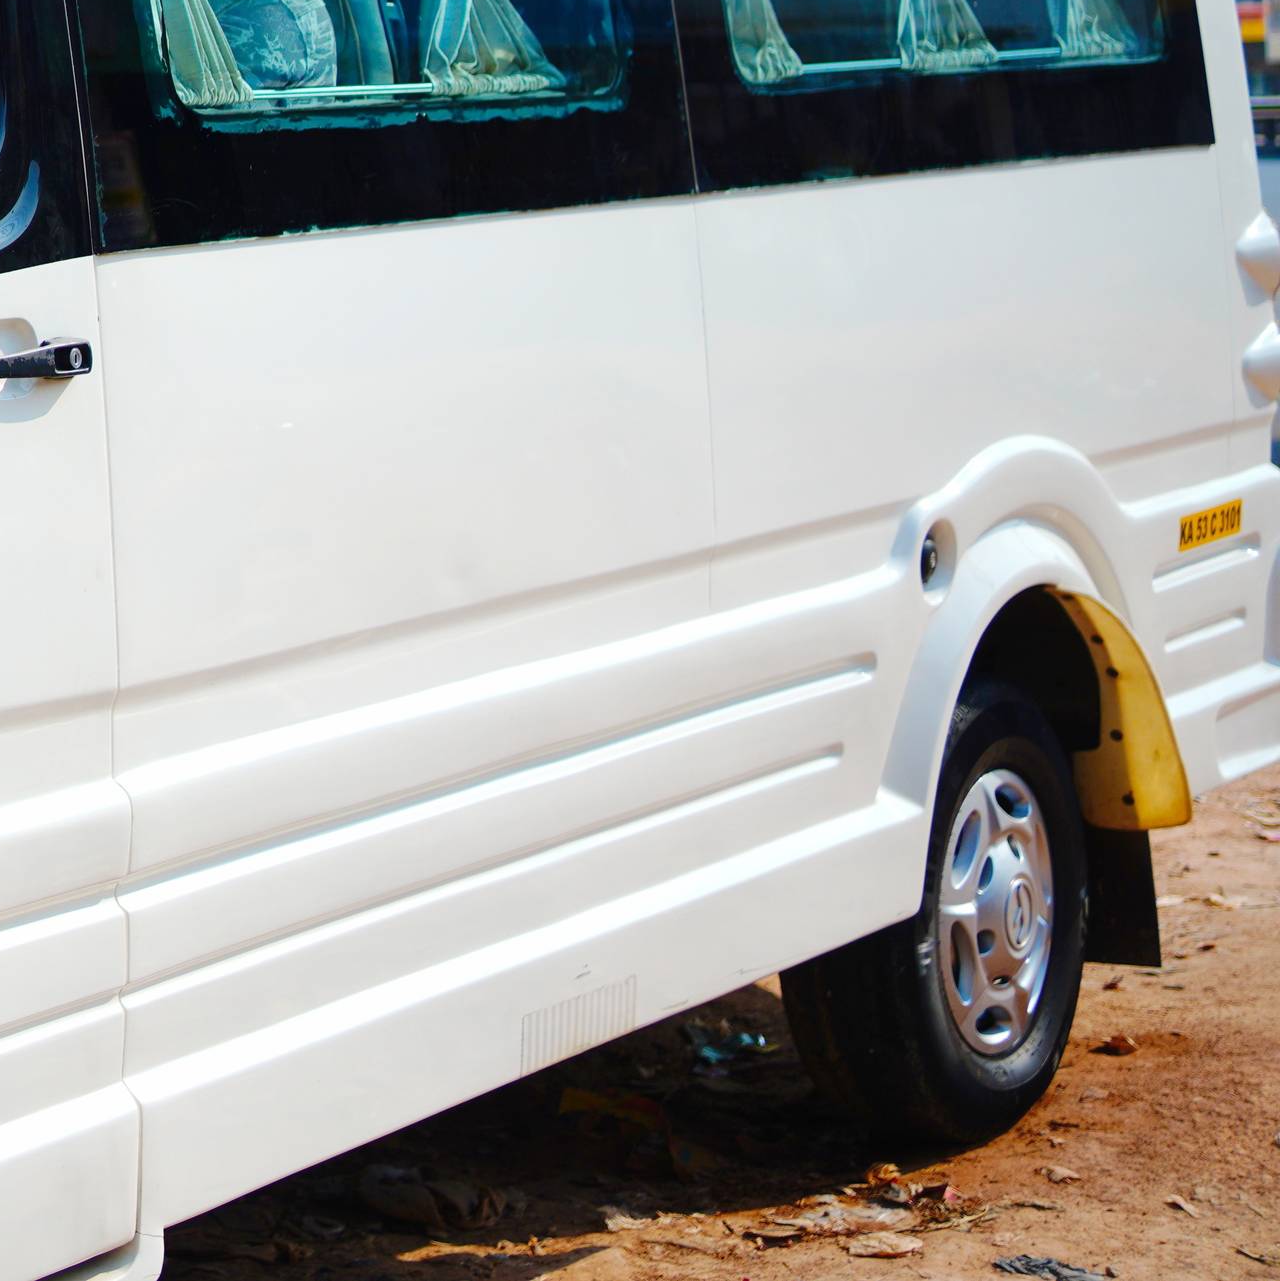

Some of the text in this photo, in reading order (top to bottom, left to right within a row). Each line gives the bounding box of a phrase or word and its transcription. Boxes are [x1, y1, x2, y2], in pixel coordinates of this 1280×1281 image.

[1180, 503, 1242, 546] KA 53 C 3101
